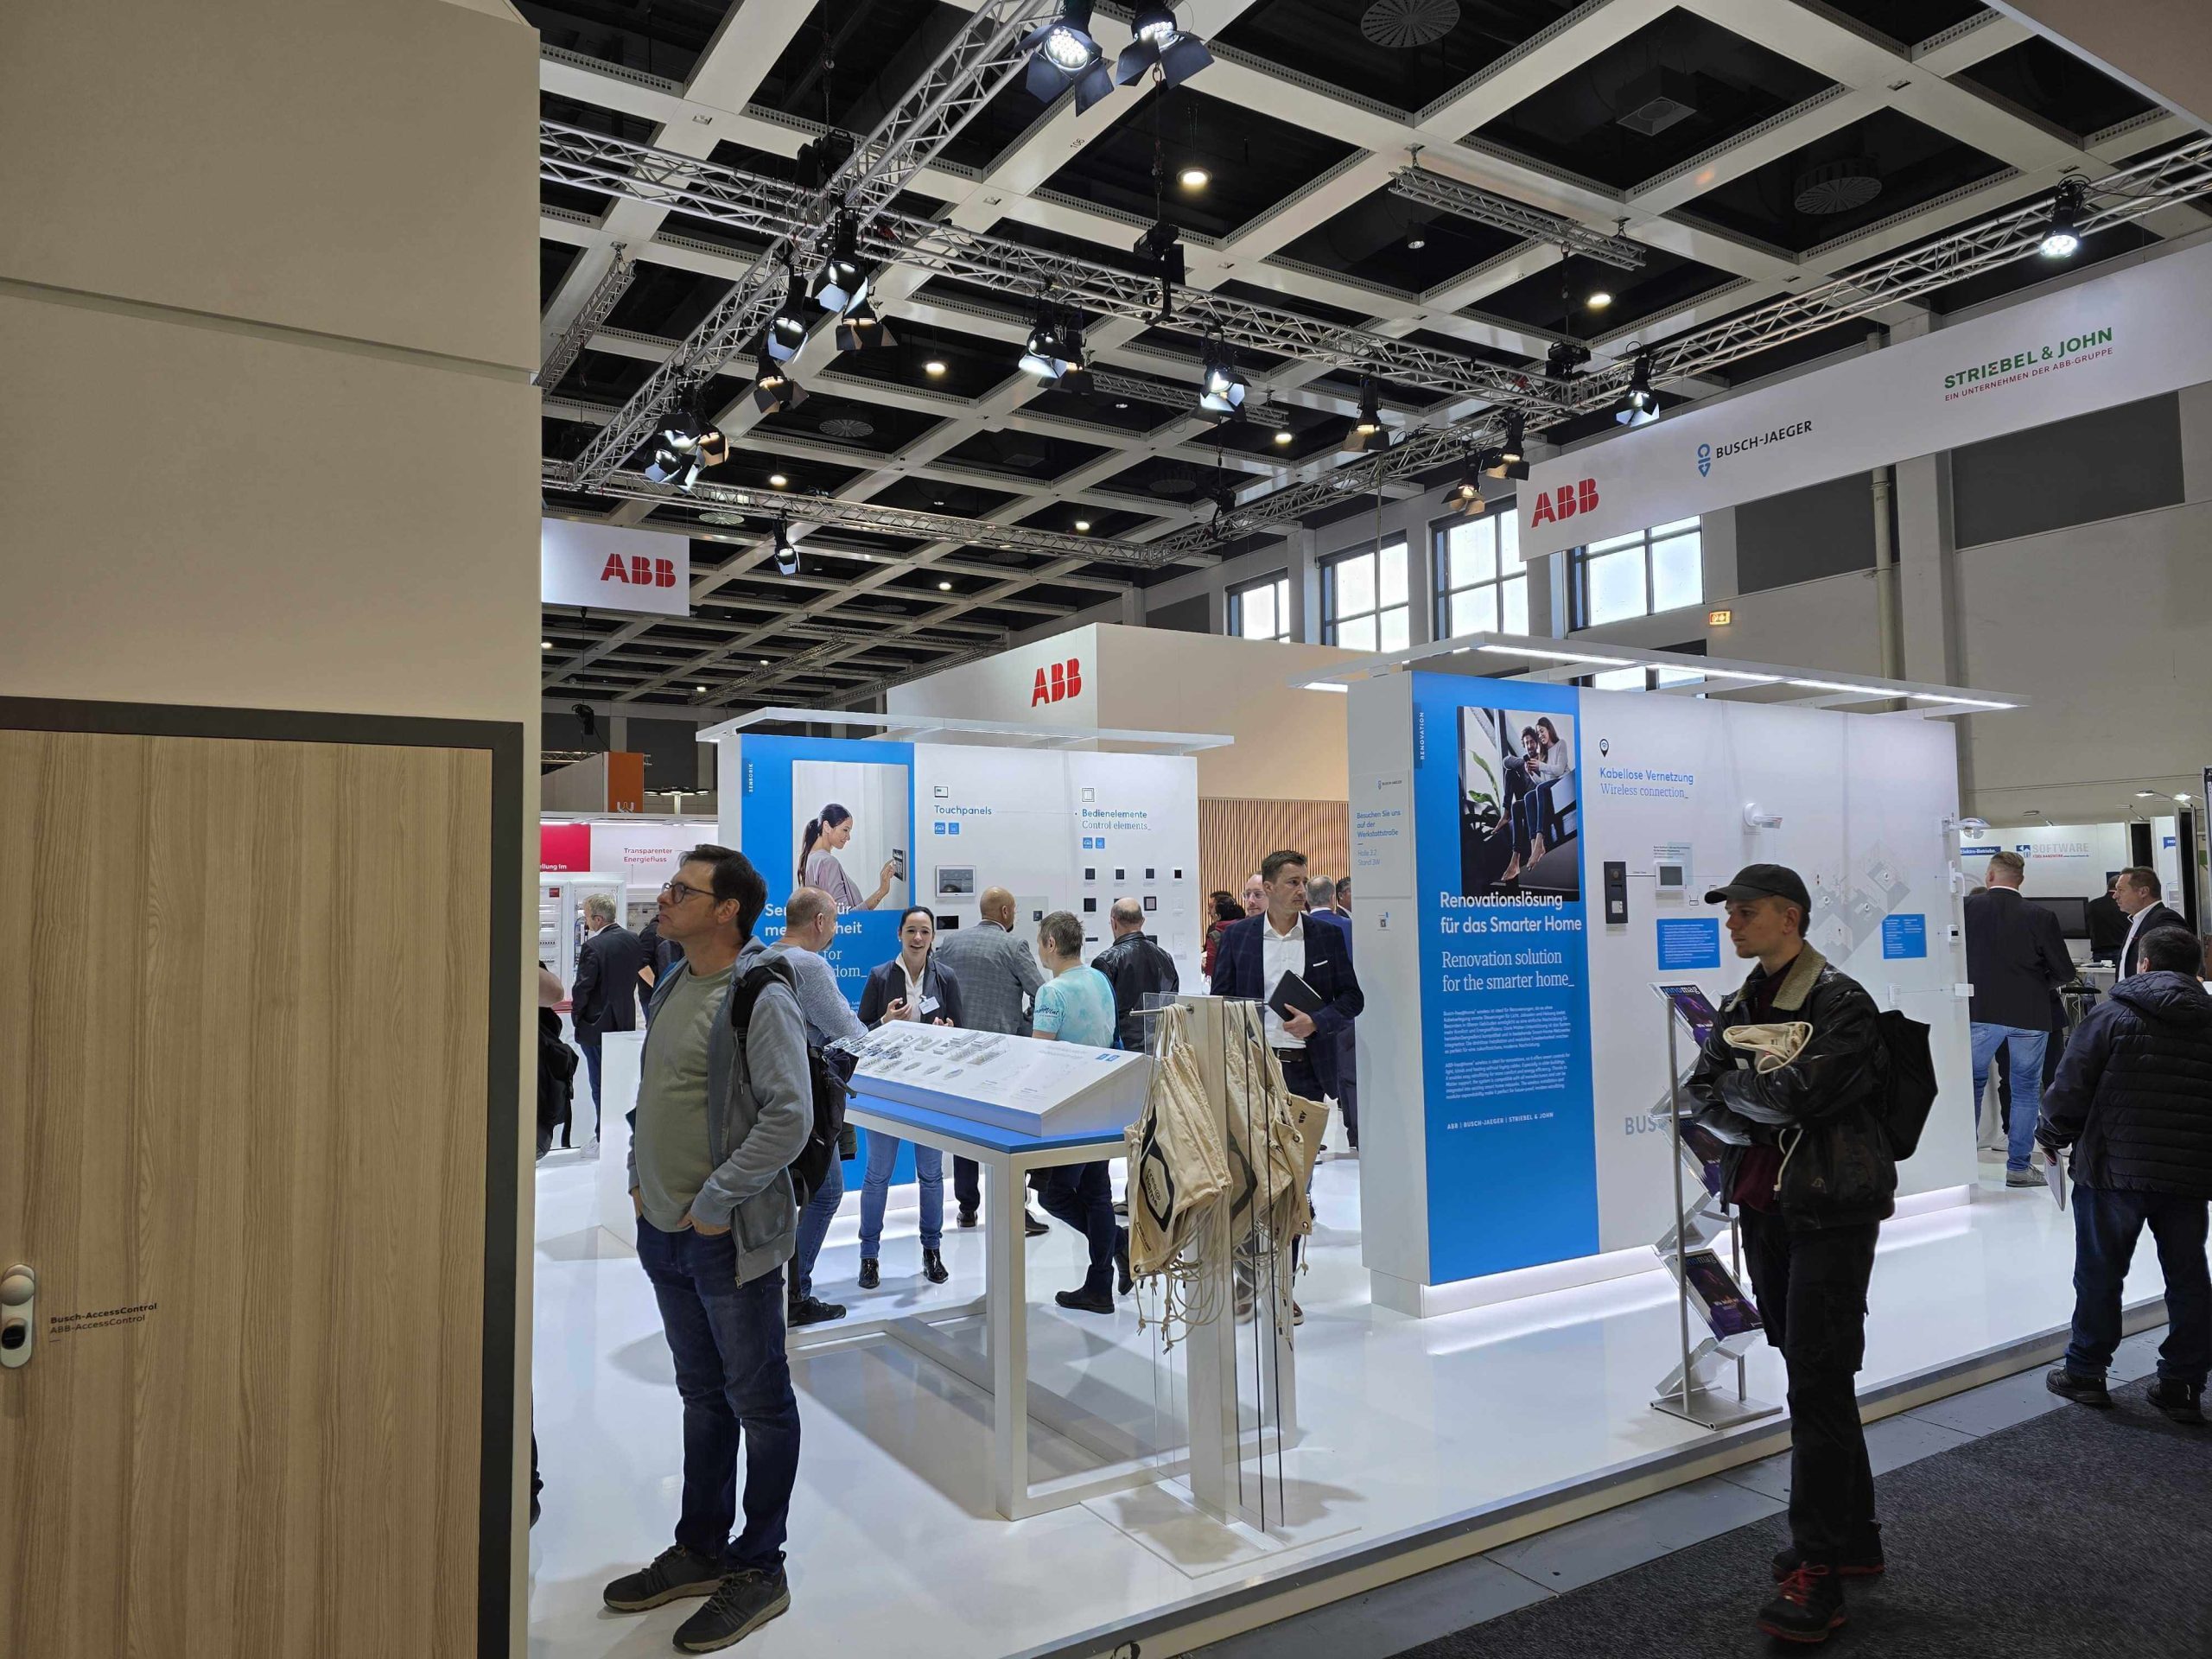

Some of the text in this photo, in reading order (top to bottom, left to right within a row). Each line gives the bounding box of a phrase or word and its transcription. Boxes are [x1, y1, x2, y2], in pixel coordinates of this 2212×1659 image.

[1945, 327, 2113, 389] STRIEBEL & JOHN
[1945, 346, 2113, 402] EIN UNTERNEHMEN DER ABB-GRUPPE
[1716, 420, 1813, 459] BUSCH-JAEGER
[1531, 478, 1599, 528] ABB
[601, 553, 677, 588] ABB
[1032, 658, 1082, 708] ABB
[1599, 766, 1694, 785] Kabellose Vernetzung
[1600, 783, 1637, 796] Wireless
[934, 805, 992, 816] Touchpanels
[1082, 809, 1147, 818] Bedienelemente
[1357, 810, 1382, 819] Besuchen
[1082, 820, 1111, 830] Control
[2032, 843, 2089, 854] SOFTWARE
[836, 902, 851, 915] ür
[1440, 891, 1563, 911] Renovationslösung
[835, 921, 862, 934] heit
[1440, 915, 1582, 934] für das Smarter Home
[1442, 949, 1562, 969] Renovation solution
[835, 964, 868, 978] dom_
[1443, 975, 1460, 992] for
[1464, 974, 1484, 991] the
[1486, 973, 1534, 989] smarter
[1463, 1117, 1504, 1128] BUSCH-JAEGER
[1509, 1115, 1533, 1123] STRIEBEL
[1624, 1115, 1657, 1135] BUS
[50, 1302, 157, 1324] Busch-AccessControl
[49, 1314, 145, 1334] ABB-AccessControl
